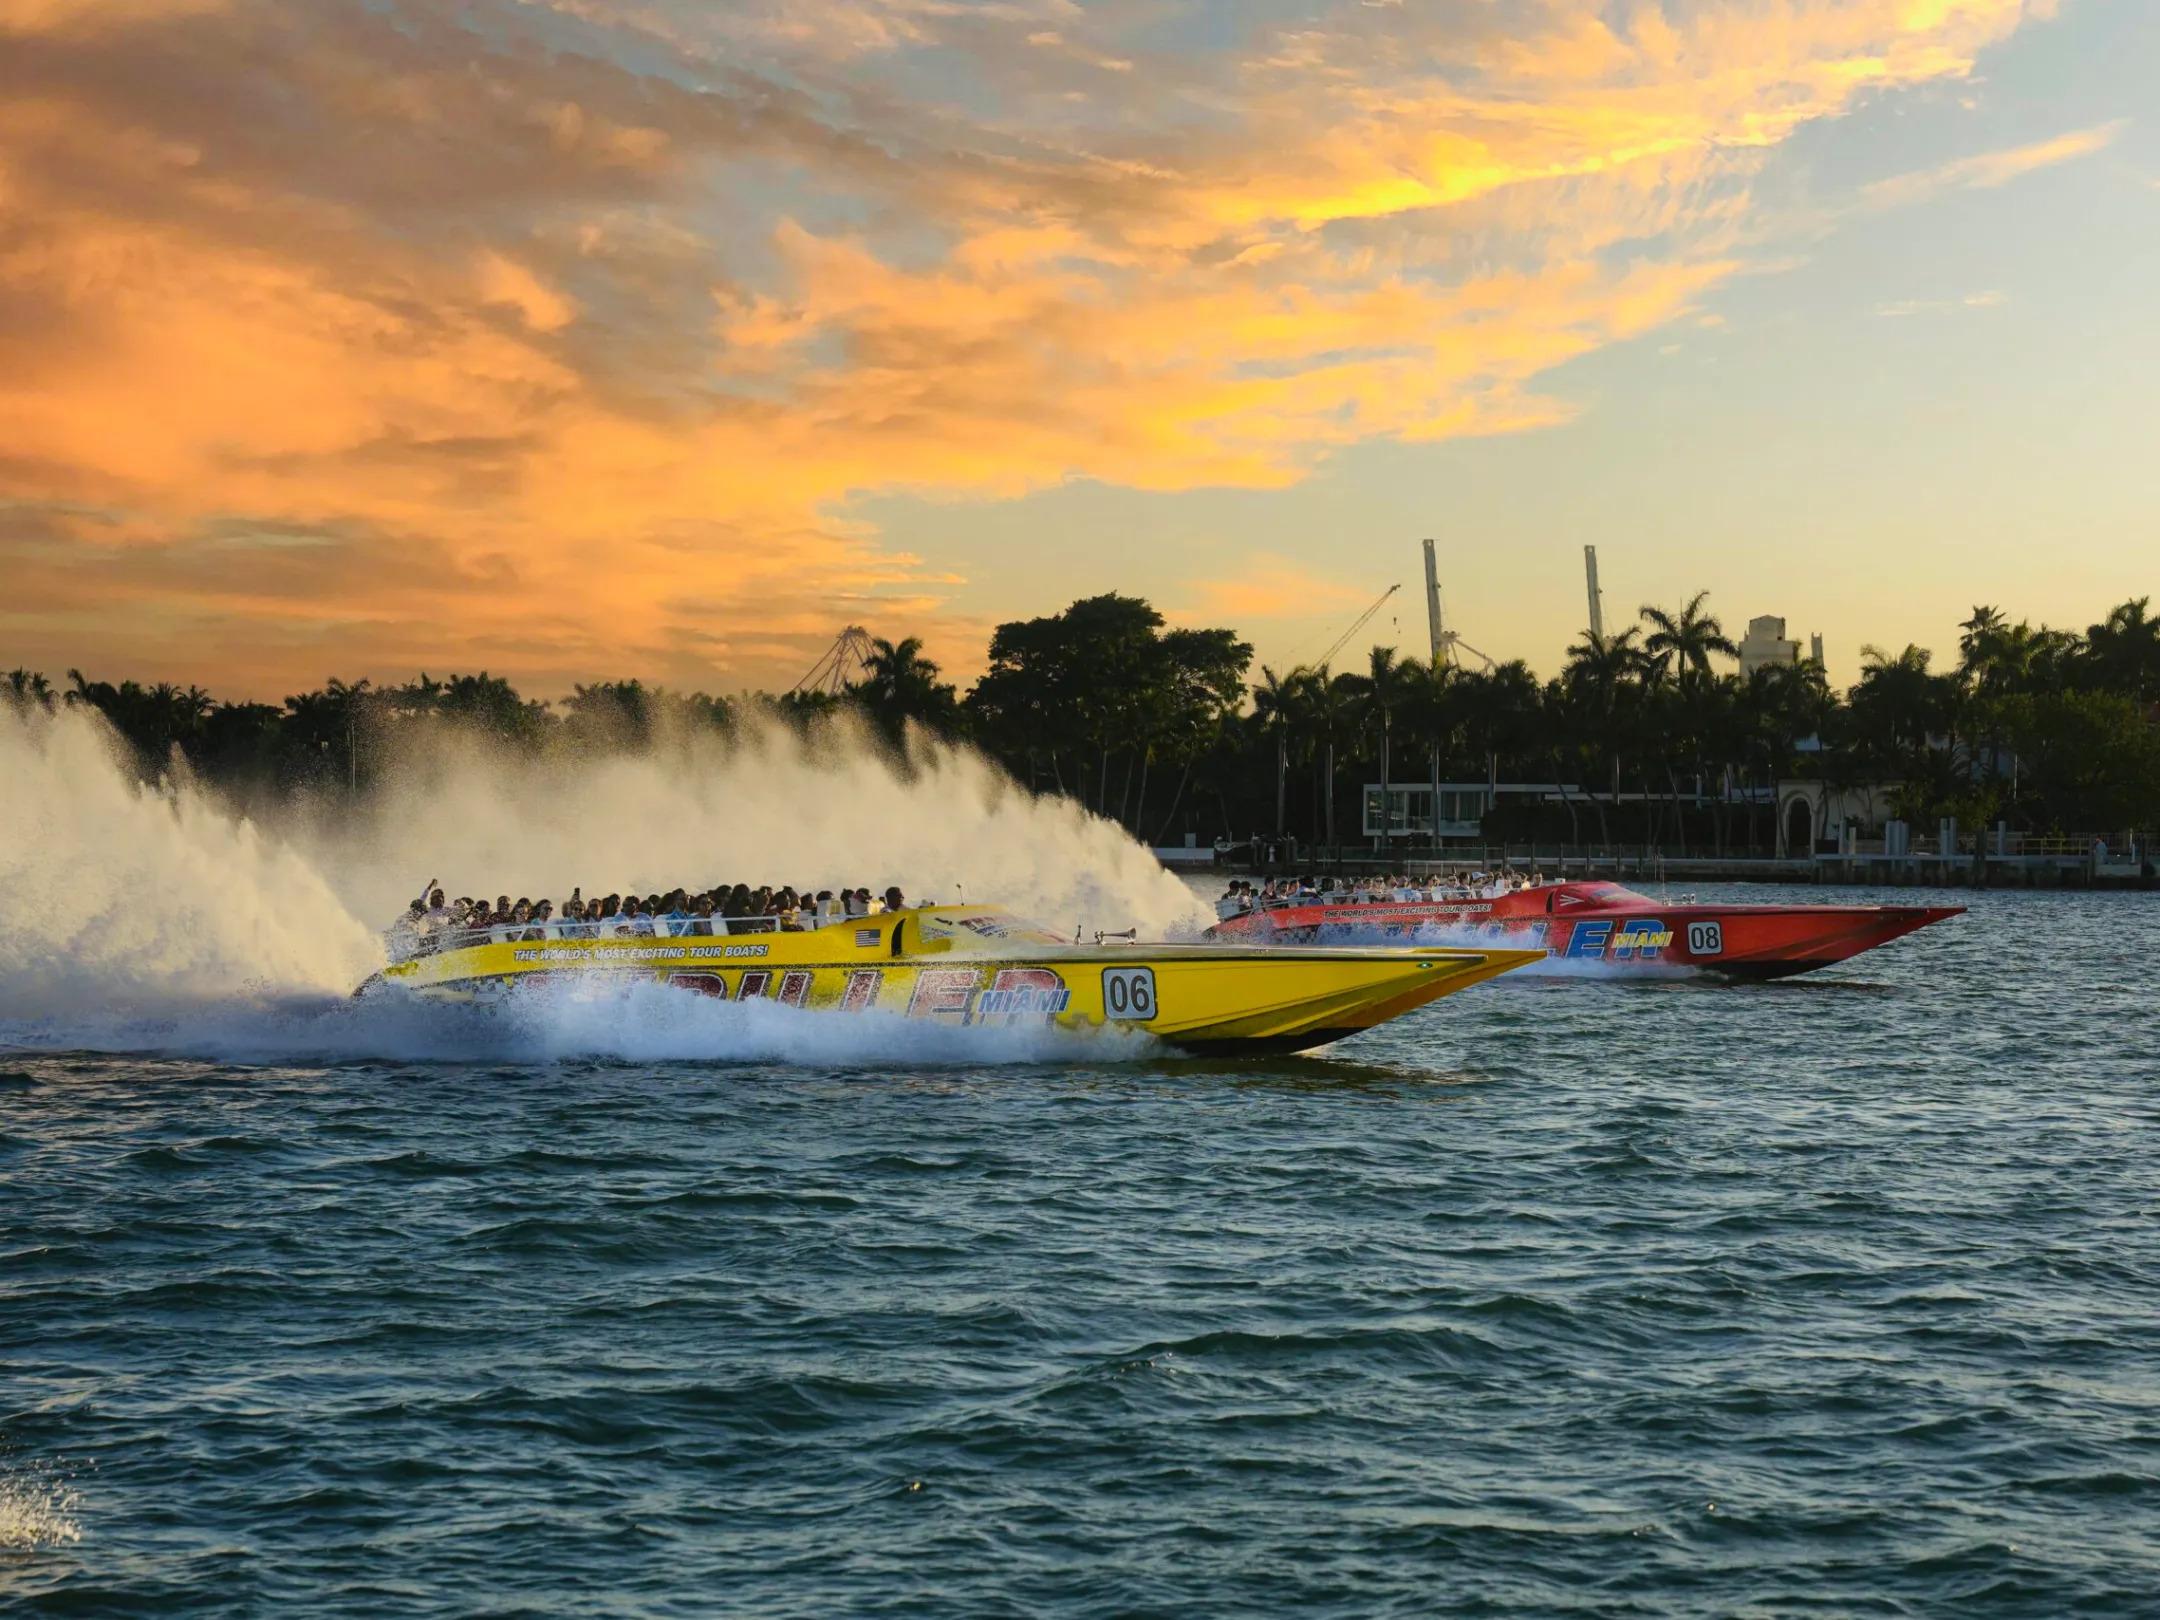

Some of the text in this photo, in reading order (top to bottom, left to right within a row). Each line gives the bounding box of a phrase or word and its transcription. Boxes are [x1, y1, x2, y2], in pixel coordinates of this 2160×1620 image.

[1611, 931, 1673, 948] MIAMI
[1690, 926, 1719, 949] 08
[514, 944, 769, 961] THE WORLD'S MOST EXCITING TOUR BOATS!
[978, 990, 1070, 1012] MIAMI
[1109, 975, 1150, 1013] 06
